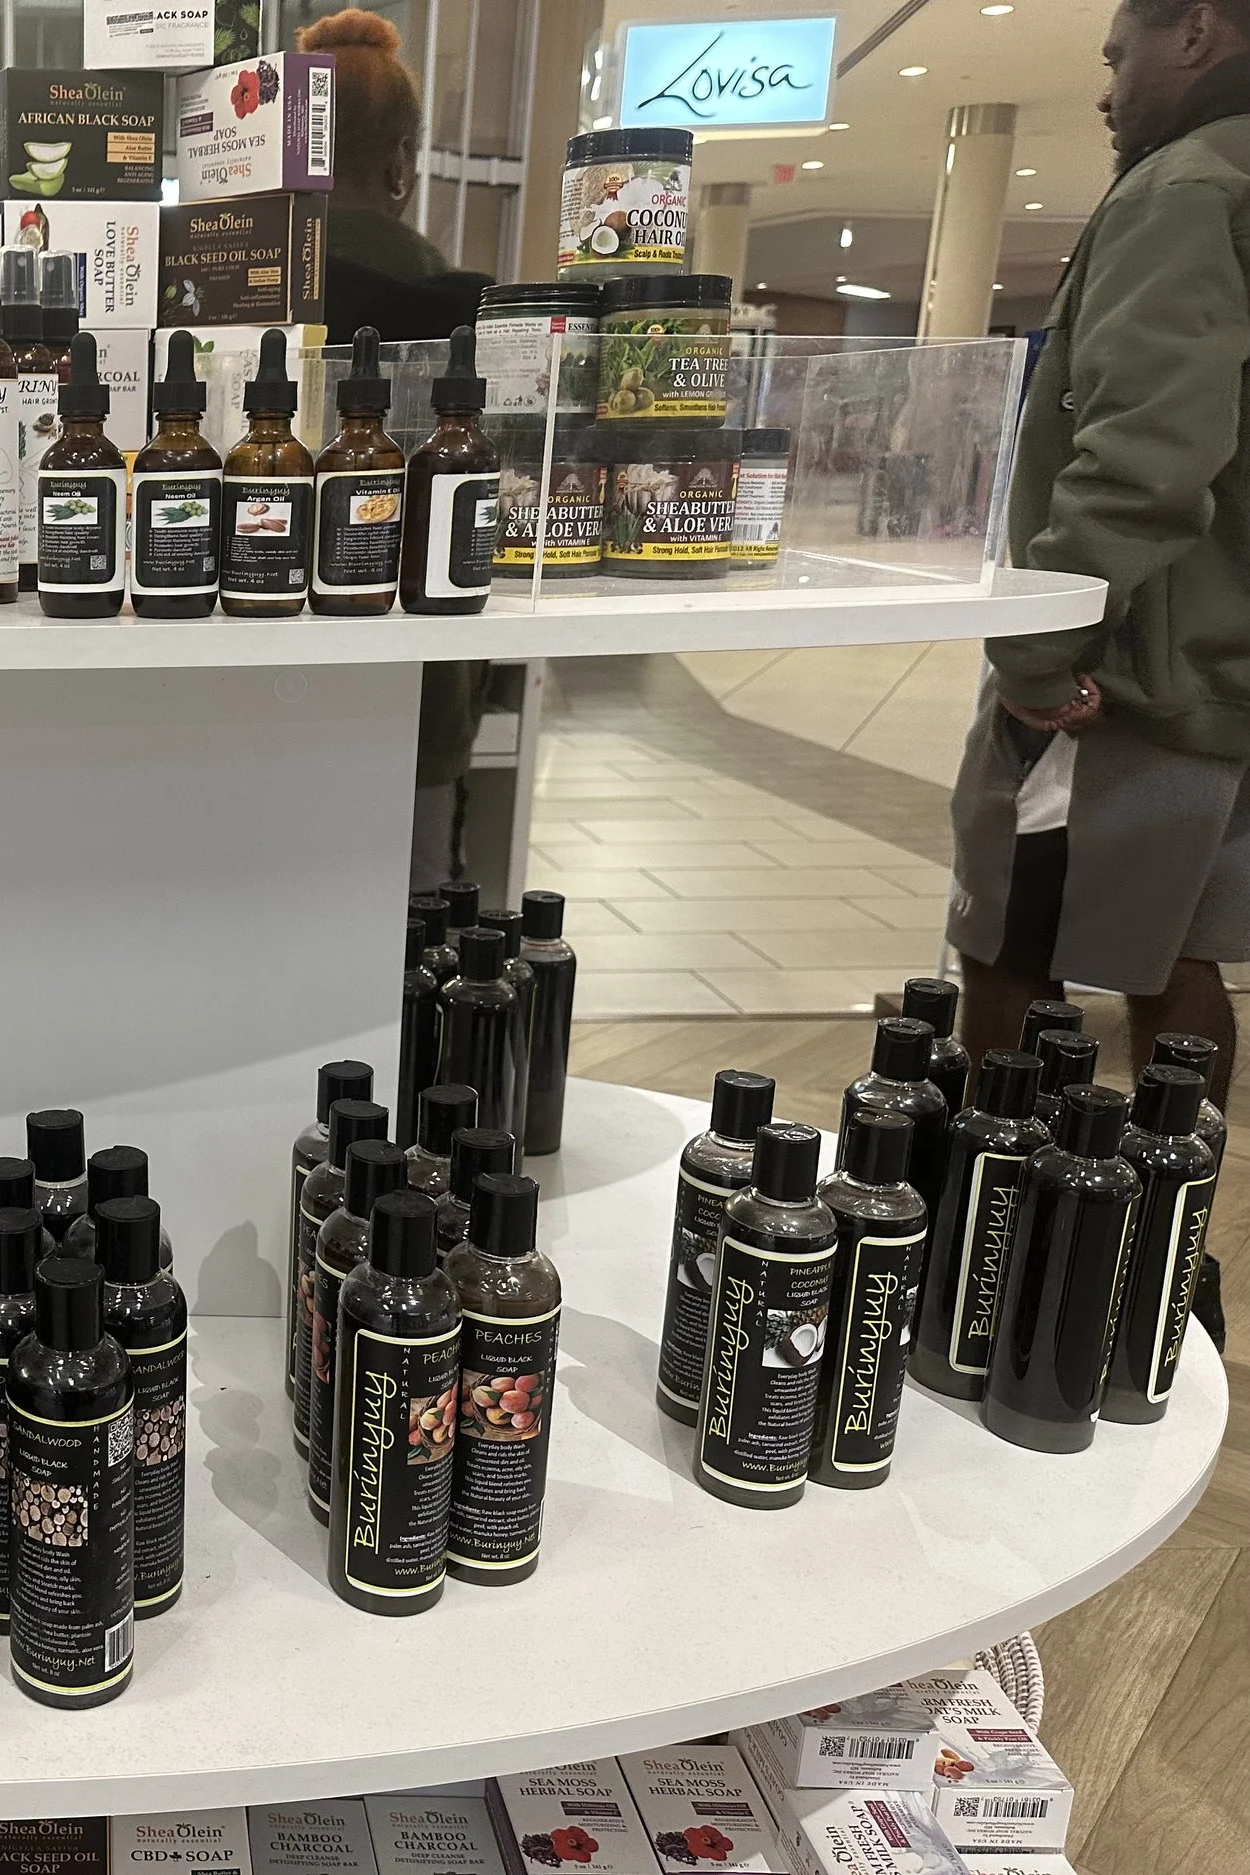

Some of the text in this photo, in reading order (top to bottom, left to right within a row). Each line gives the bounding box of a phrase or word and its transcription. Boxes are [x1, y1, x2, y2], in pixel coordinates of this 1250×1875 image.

[637, 31, 813, 117] Lovisa
[18, 112, 155, 127] AFRICAN BLACK SOAP
[213, 126, 237, 140] SOAP
[188, 134, 266, 159] SEA MOSS HERBAL
[651, 194, 686, 206] ORGANIC
[634, 229, 673, 245] HAIR
[165, 248, 281, 267] BLACK SEED OIL SOAP
[634, 249, 651, 260] Scalp
[94, 248, 104, 286] SOAP
[105, 221, 116, 313] LOVE BUTTER
[685, 347, 724, 355] ORGANIC
[669, 357, 729, 370] TEA TREE
[673, 373, 726, 387] & OLIVE
[681, 390, 705, 398] LEMON
[355, 488, 386, 496] Vitamin
[679, 490, 723, 499] ORGANIC
[547, 495, 590, 504] ORGANIC
[643, 518, 657, 533] &
[660, 518, 706, 533] ALOE
[556, 539, 584, 547] VITAMIN
[689, 534, 717, 542] VITAMIN
[968, 1185, 1019, 1339] Burinyuy
[1164, 1206, 1208, 1367] Burinyuy
[756, 1260, 769, 1327] NATURAL
[801, 1299, 818, 1307] SOAP
[475, 1328, 542, 1346] PEACHES
[480, 1354, 533, 1363] LIQUID BLACK
[708, 1275, 754, 1438] Burinyuy
[844, 1271, 899, 1435] Burinyuy
[495, 1365, 518, 1374] SOAP
[399, 1347, 410, 1422] NATURAL
[12, 1420, 82, 1448] SANDALWOOD
[353, 1370, 398, 1548] Burinyuy
[943, 1716, 980, 1725] SOAP
[529, 1778, 597, 1787] SEA MOSS
[657, 1778, 726, 1788] SEA MOSS
[519, 1787, 613, 1797] HERBAL SOAP
[649, 1786, 743, 1798] HERBAL SOAP
[277, 1832, 343, 1843] BAMBOO
[401, 1831, 467, 1842] BAMBOO
[270, 1842, 354, 1853] CHARCOAL
[394, 1840, 478, 1851] CHARCOAL
[34, 1852, 72, 1863] SEED
[74, 1852, 100, 1862] OIL
[131, 1849, 234, 1862] CBD SOAP
[20, 1863, 60, 1874] SOAP
